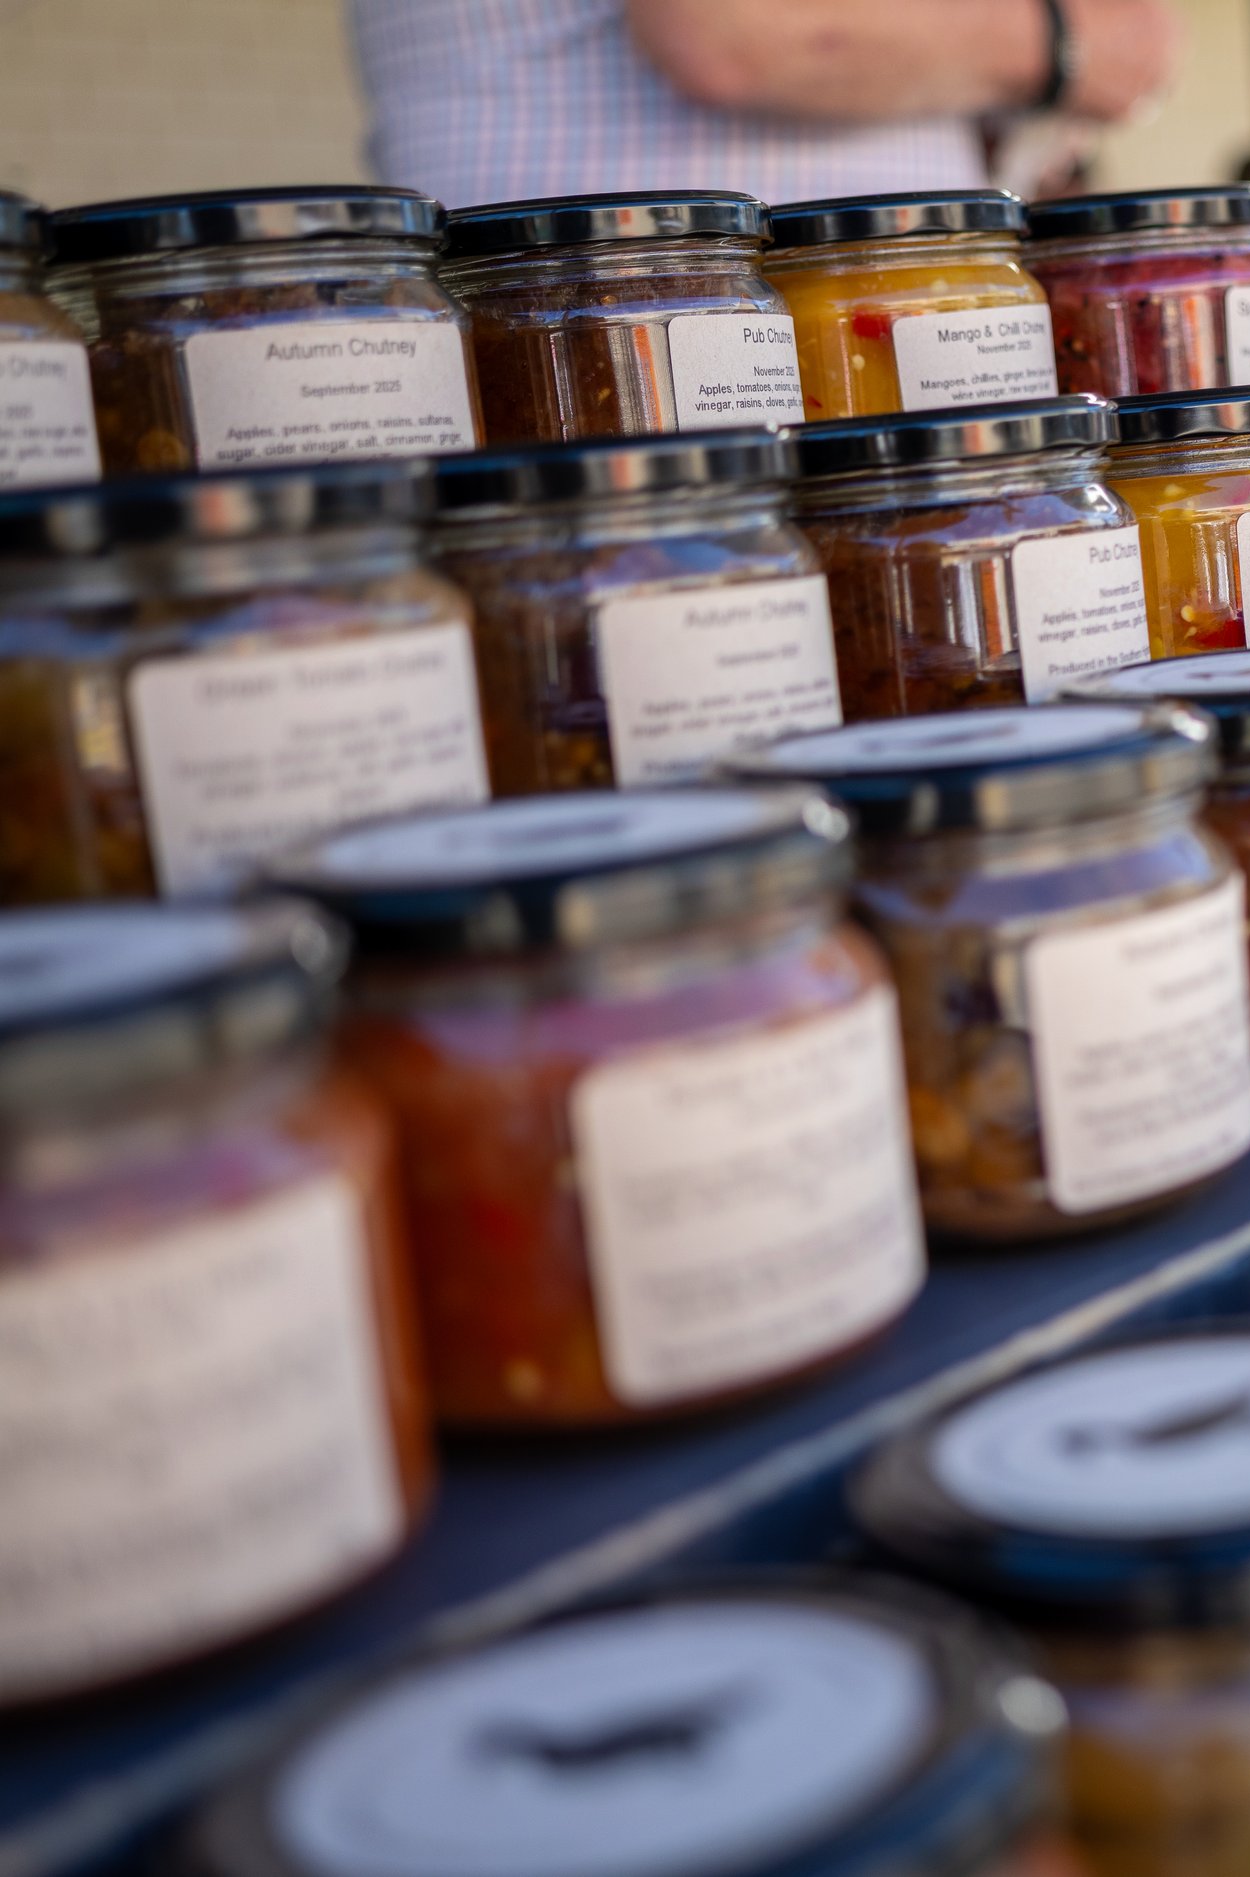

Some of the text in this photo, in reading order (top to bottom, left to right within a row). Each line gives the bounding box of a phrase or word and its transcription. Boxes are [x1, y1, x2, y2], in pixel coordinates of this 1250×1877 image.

[743, 327, 793, 347] Pub Chutney
[937, 328, 982, 343] Mango
[984, 325, 992, 338] &
[998, 322, 1019, 337] Chilli
[265, 338, 417, 361] Autumn Chutney
[977, 343, 1015, 355] November
[753, 366, 785, 377] November
[301, 381, 370, 399] September
[698, 381, 792, 397] Apples, tomatoes, onions,
[695, 399, 735, 412] vinegar,
[736, 398, 765, 409] raisins,
[766, 396, 787, 408] cloves,
[1090, 546, 1112, 564] Pub
[1048, 660, 1096, 676] Produced
